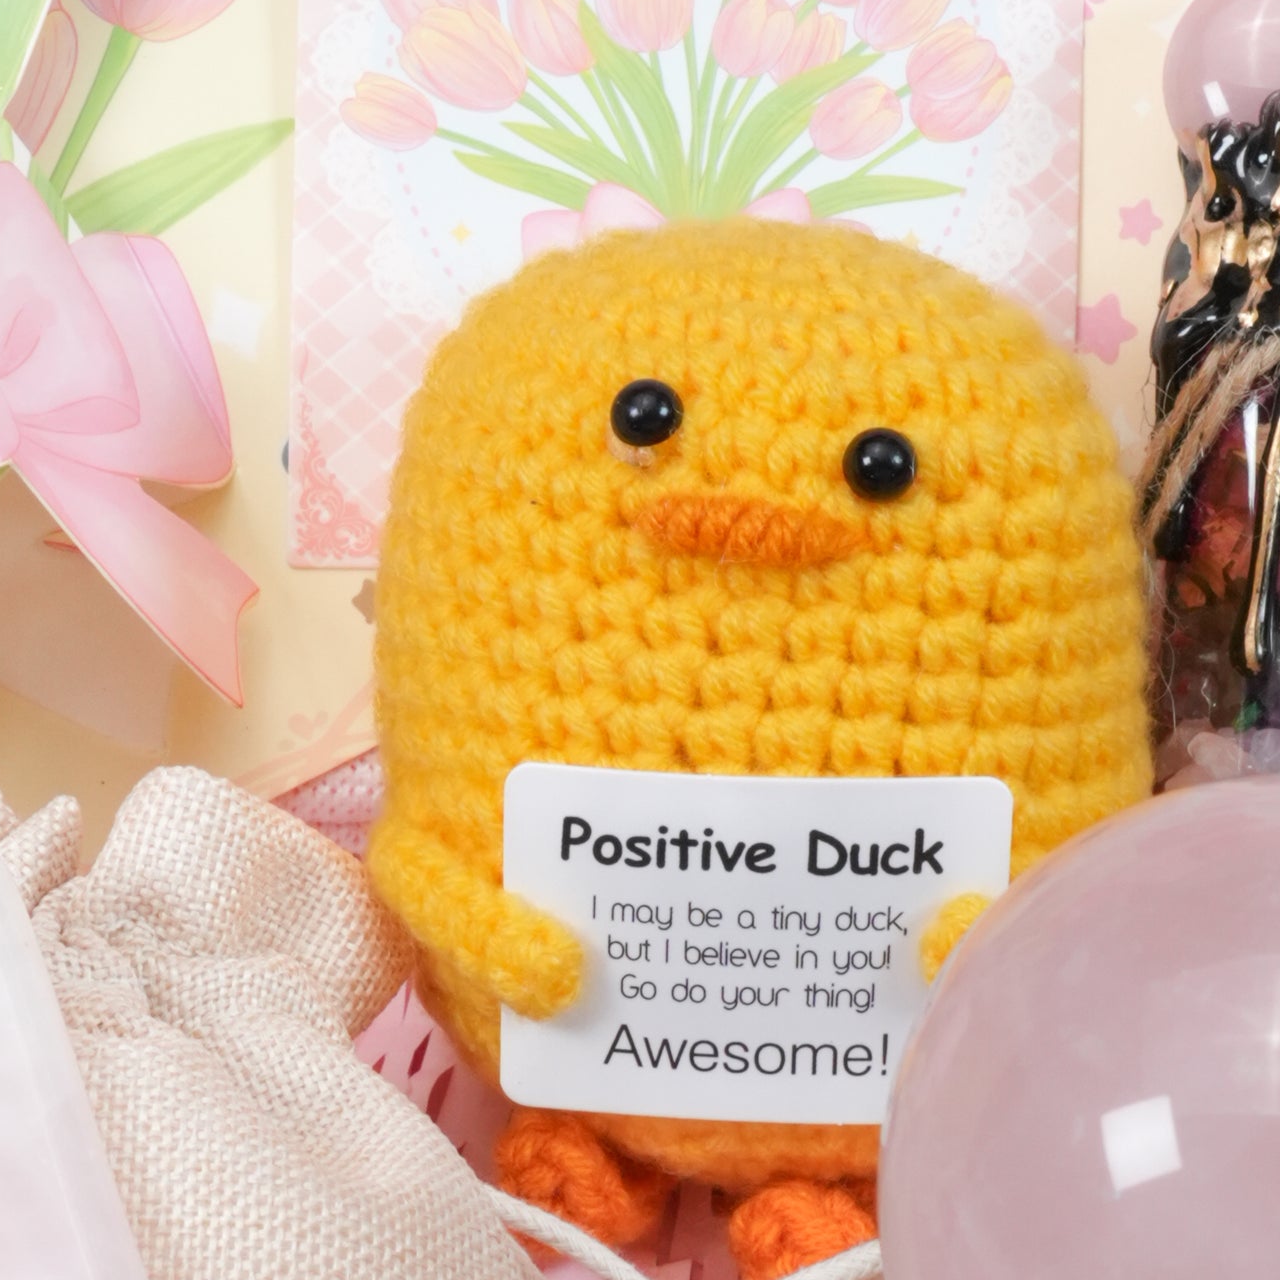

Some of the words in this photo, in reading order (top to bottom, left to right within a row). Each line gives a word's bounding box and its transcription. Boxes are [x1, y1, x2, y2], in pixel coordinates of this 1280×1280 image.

[560, 815, 777, 874] Positive
[806, 827, 945, 878] Duck
[591, 894, 597, 920] I
[611, 901, 674, 930] may
[687, 901, 723, 929] be
[737, 910, 757, 930] a
[771, 904, 821, 936] tiny
[835, 906, 909, 937] duck,
[607, 934, 652, 963] but
[664, 938, 670, 964] I
[683, 941, 782, 969] believe
[794, 943, 819, 970] in
[832, 945, 891, 976] you!
[620, 973, 657, 1001] Go
[671, 977, 707, 1004] do
[720, 985, 791, 1010] your
[804, 982, 876, 1013] thing!
[603, 1022, 890, 1077] Awesome!
